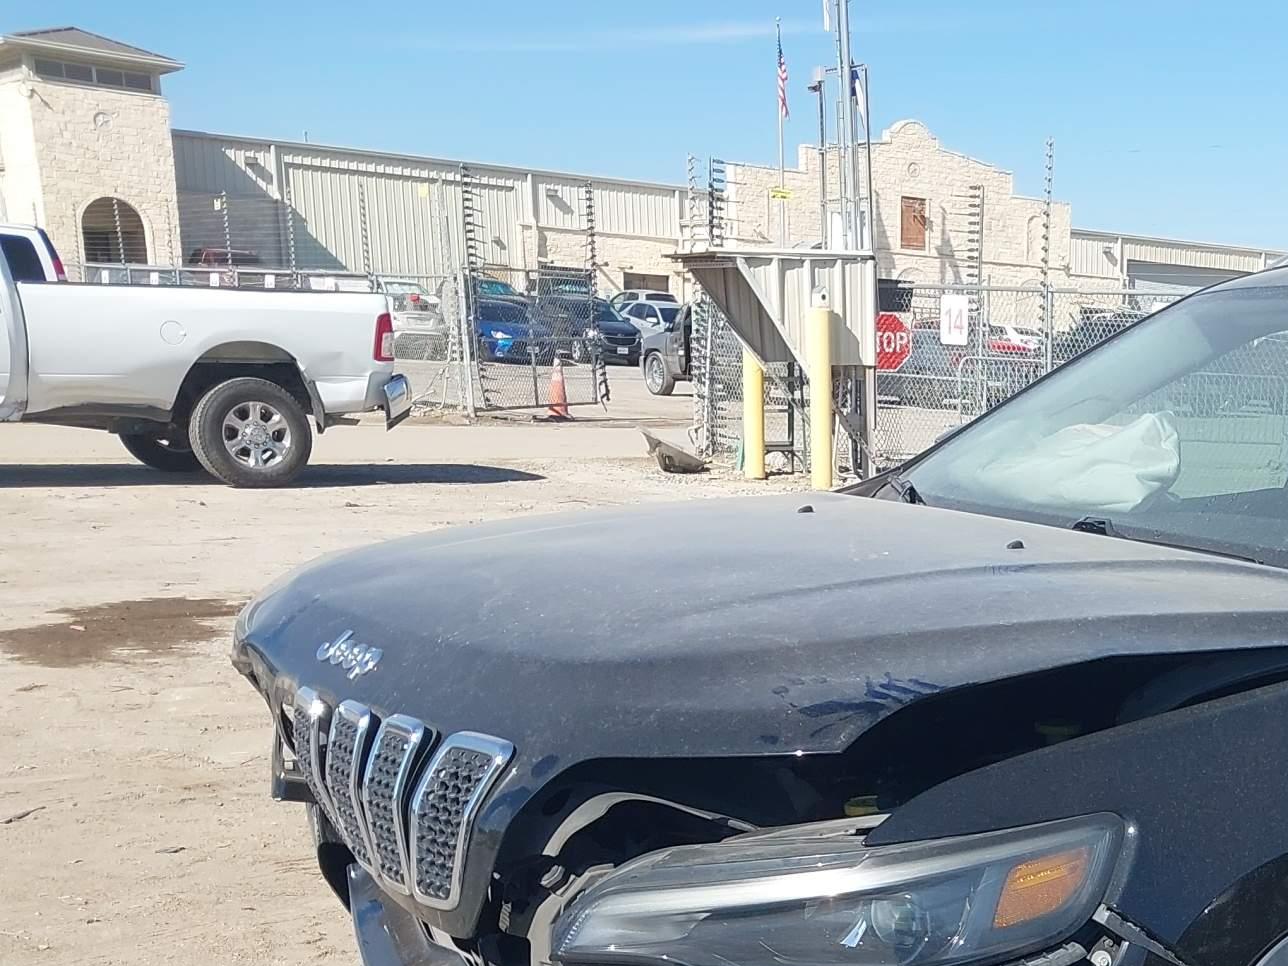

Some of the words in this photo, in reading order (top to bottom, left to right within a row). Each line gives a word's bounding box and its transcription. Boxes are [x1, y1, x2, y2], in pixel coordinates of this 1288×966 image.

[944, 308, 965, 336] 14
[876, 332, 908, 353] TOP
[316, 629, 385, 680] Jeep
